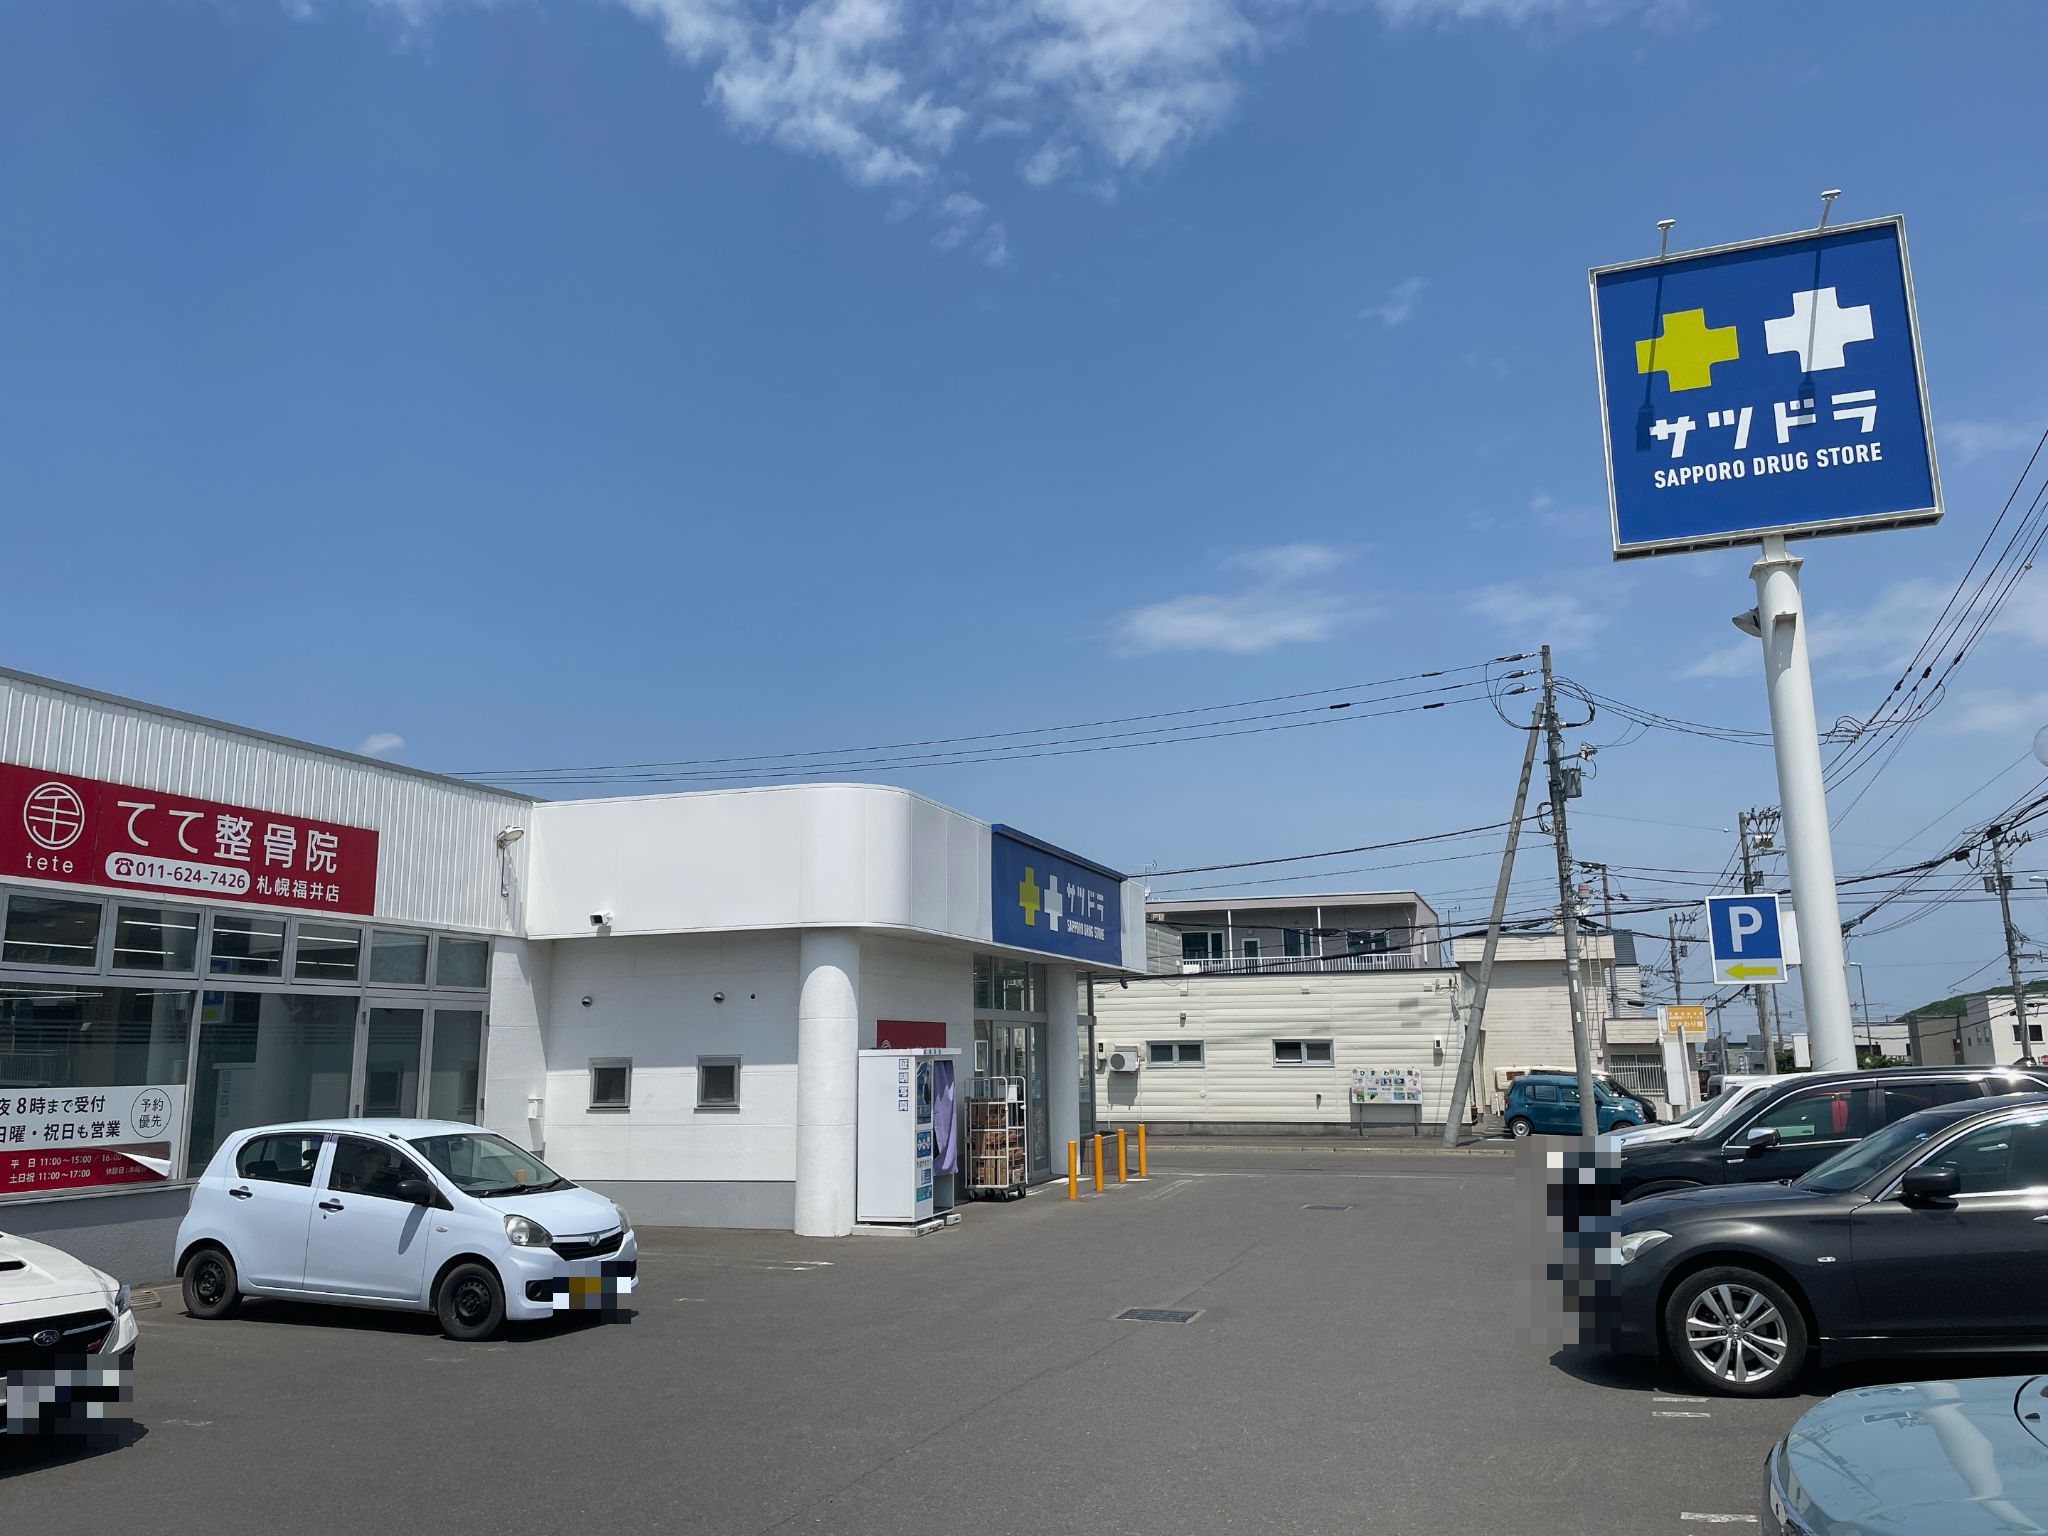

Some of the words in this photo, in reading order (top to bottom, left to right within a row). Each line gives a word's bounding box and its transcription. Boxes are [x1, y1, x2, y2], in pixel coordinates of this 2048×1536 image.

[1649, 389, 1877, 459] サツドラ
[1653, 458, 1745, 490] SAPPORO
[1753, 451, 1809, 476] DRUG
[1816, 442, 1883, 468] STORE
[117, 800, 340, 874] てて整骨院
[25, 852, 74, 874] tete
[136, 860, 246, 889] 011-624-7426
[256, 874, 341, 903] 札幌福井店
[1066, 882, 1104, 922] サツドラ
[1728, 905, 1763, 953] P
[139, 1113, 162, 1129] 優先
[140, 1097, 164, 1113] 予約
